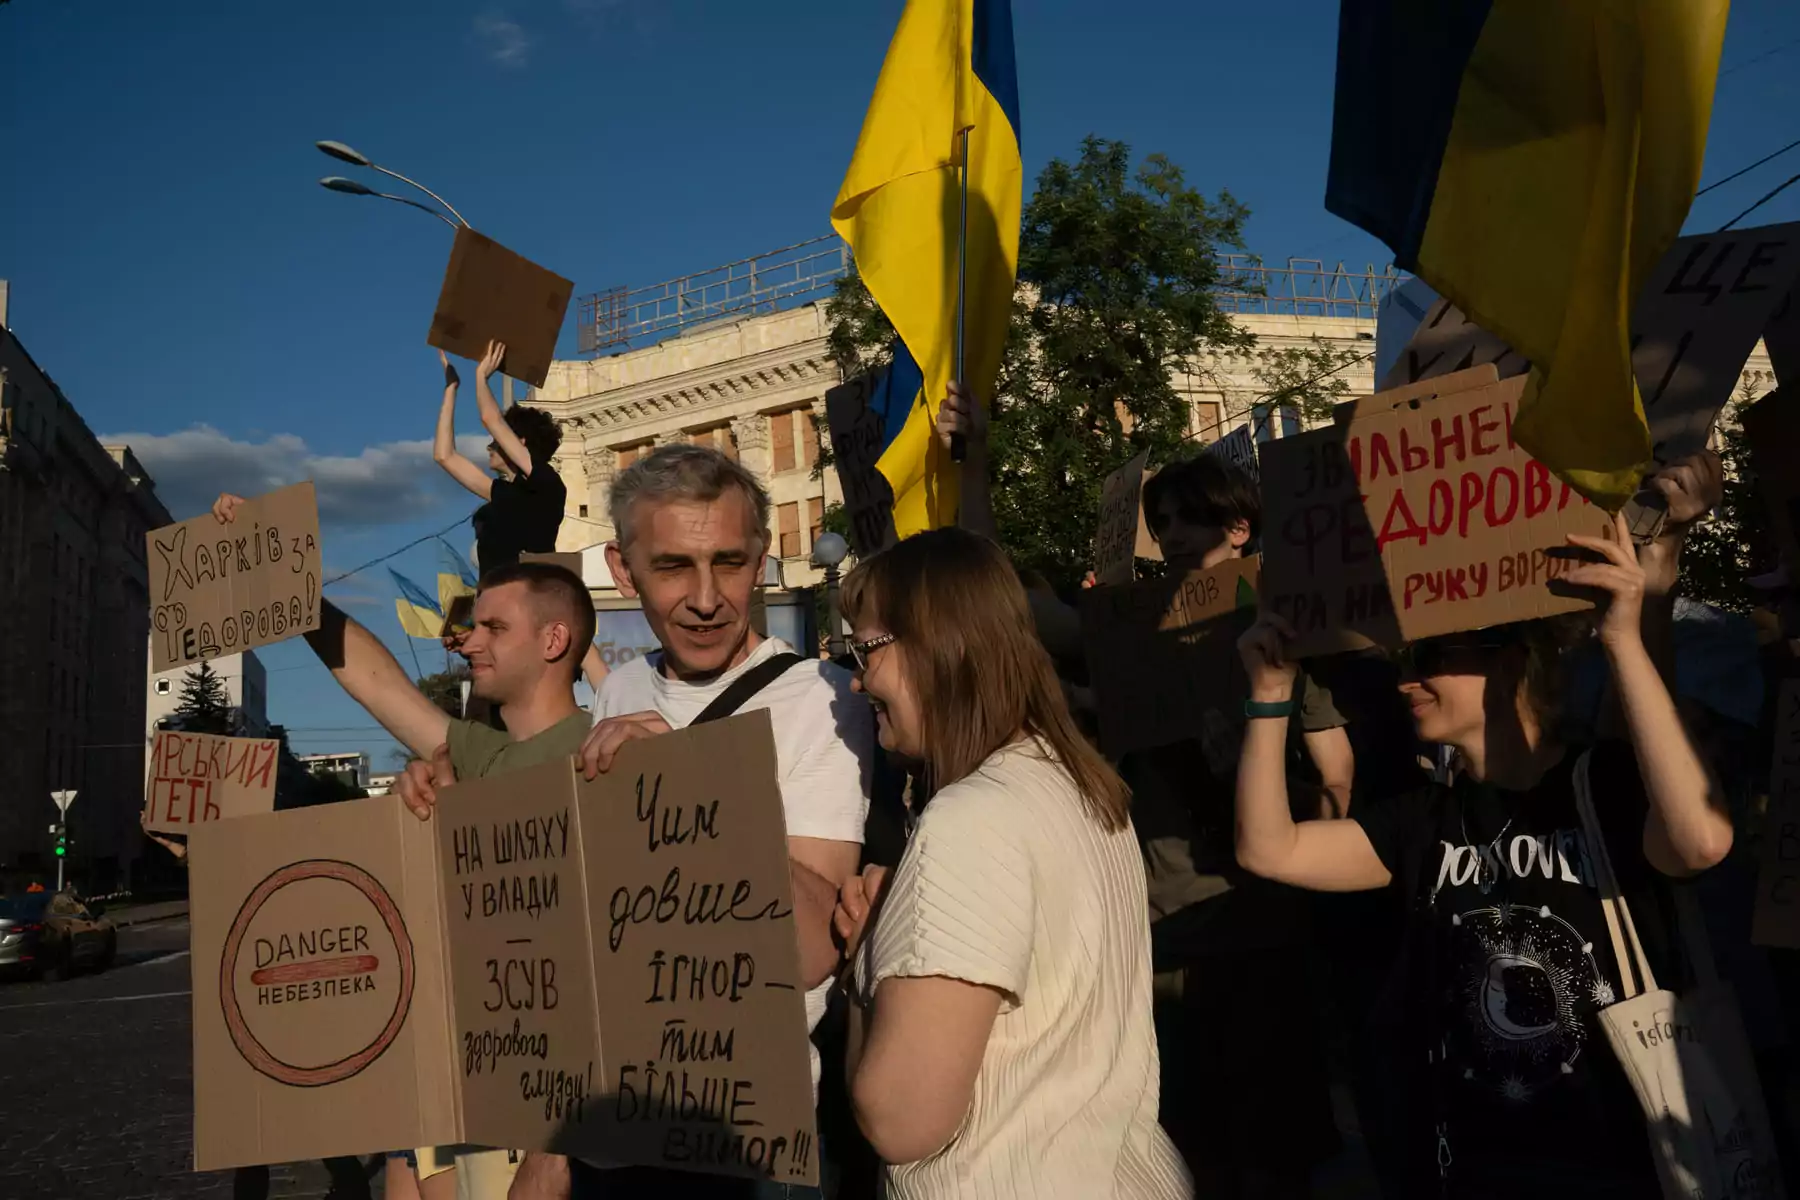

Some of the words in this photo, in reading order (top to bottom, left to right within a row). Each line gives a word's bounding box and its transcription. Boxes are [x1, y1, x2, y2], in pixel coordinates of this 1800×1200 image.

[1404, 561, 1488, 610] РУКУ
[149, 776, 221, 824] ГЕТЬ
[453, 823, 484, 875] НА
[492, 806, 569, 864] ШЛЯХУ
[482, 871, 559, 922] ВЛАДИ
[255, 925, 370, 969] DANGER
[258, 974, 376, 1005] НЕБЕЗПЕКА
[483, 957, 559, 1012] ЗСУВ
[617, 1060, 765, 1126] БІЛЬШЕ
